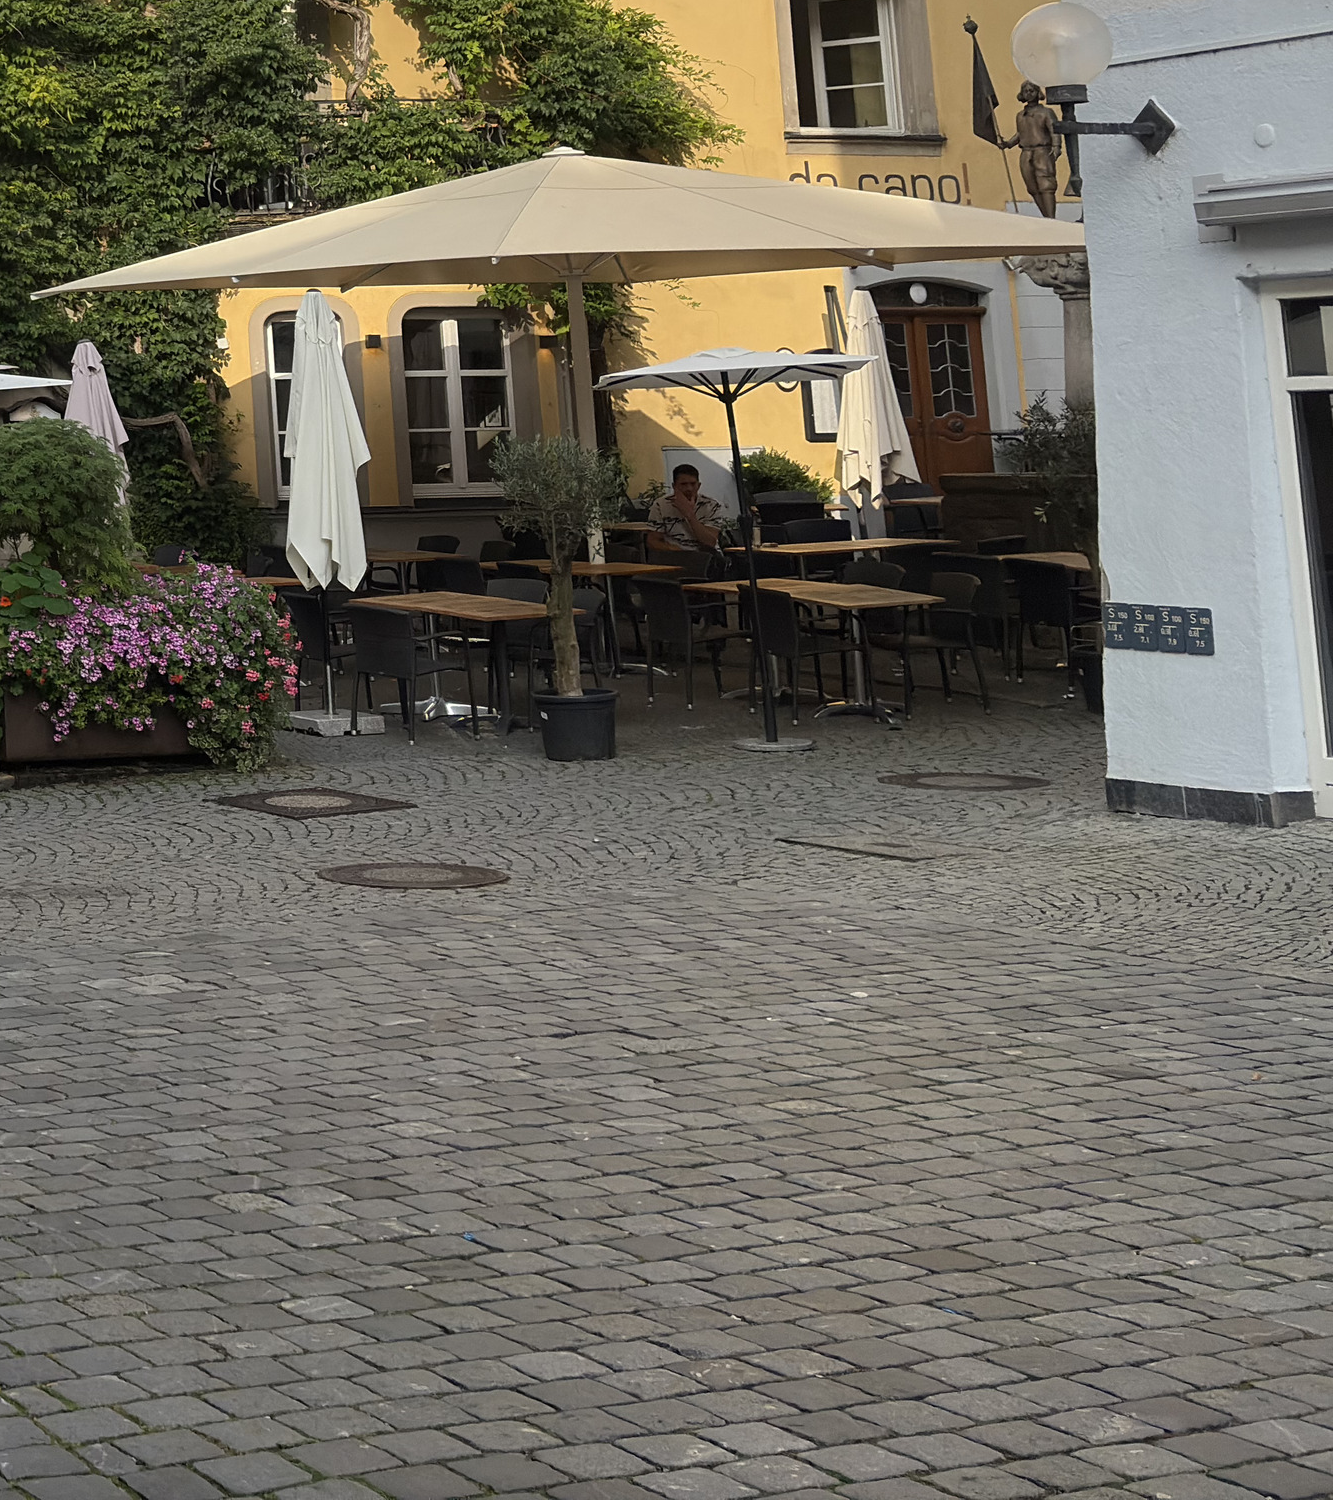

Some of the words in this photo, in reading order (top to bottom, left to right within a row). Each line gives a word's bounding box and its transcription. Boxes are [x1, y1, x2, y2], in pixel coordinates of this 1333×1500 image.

[1108, 607, 1115, 618] S
[1135, 609, 1142, 620] S
[1162, 611, 1169, 622] S
[1190, 613, 1197, 624] S
